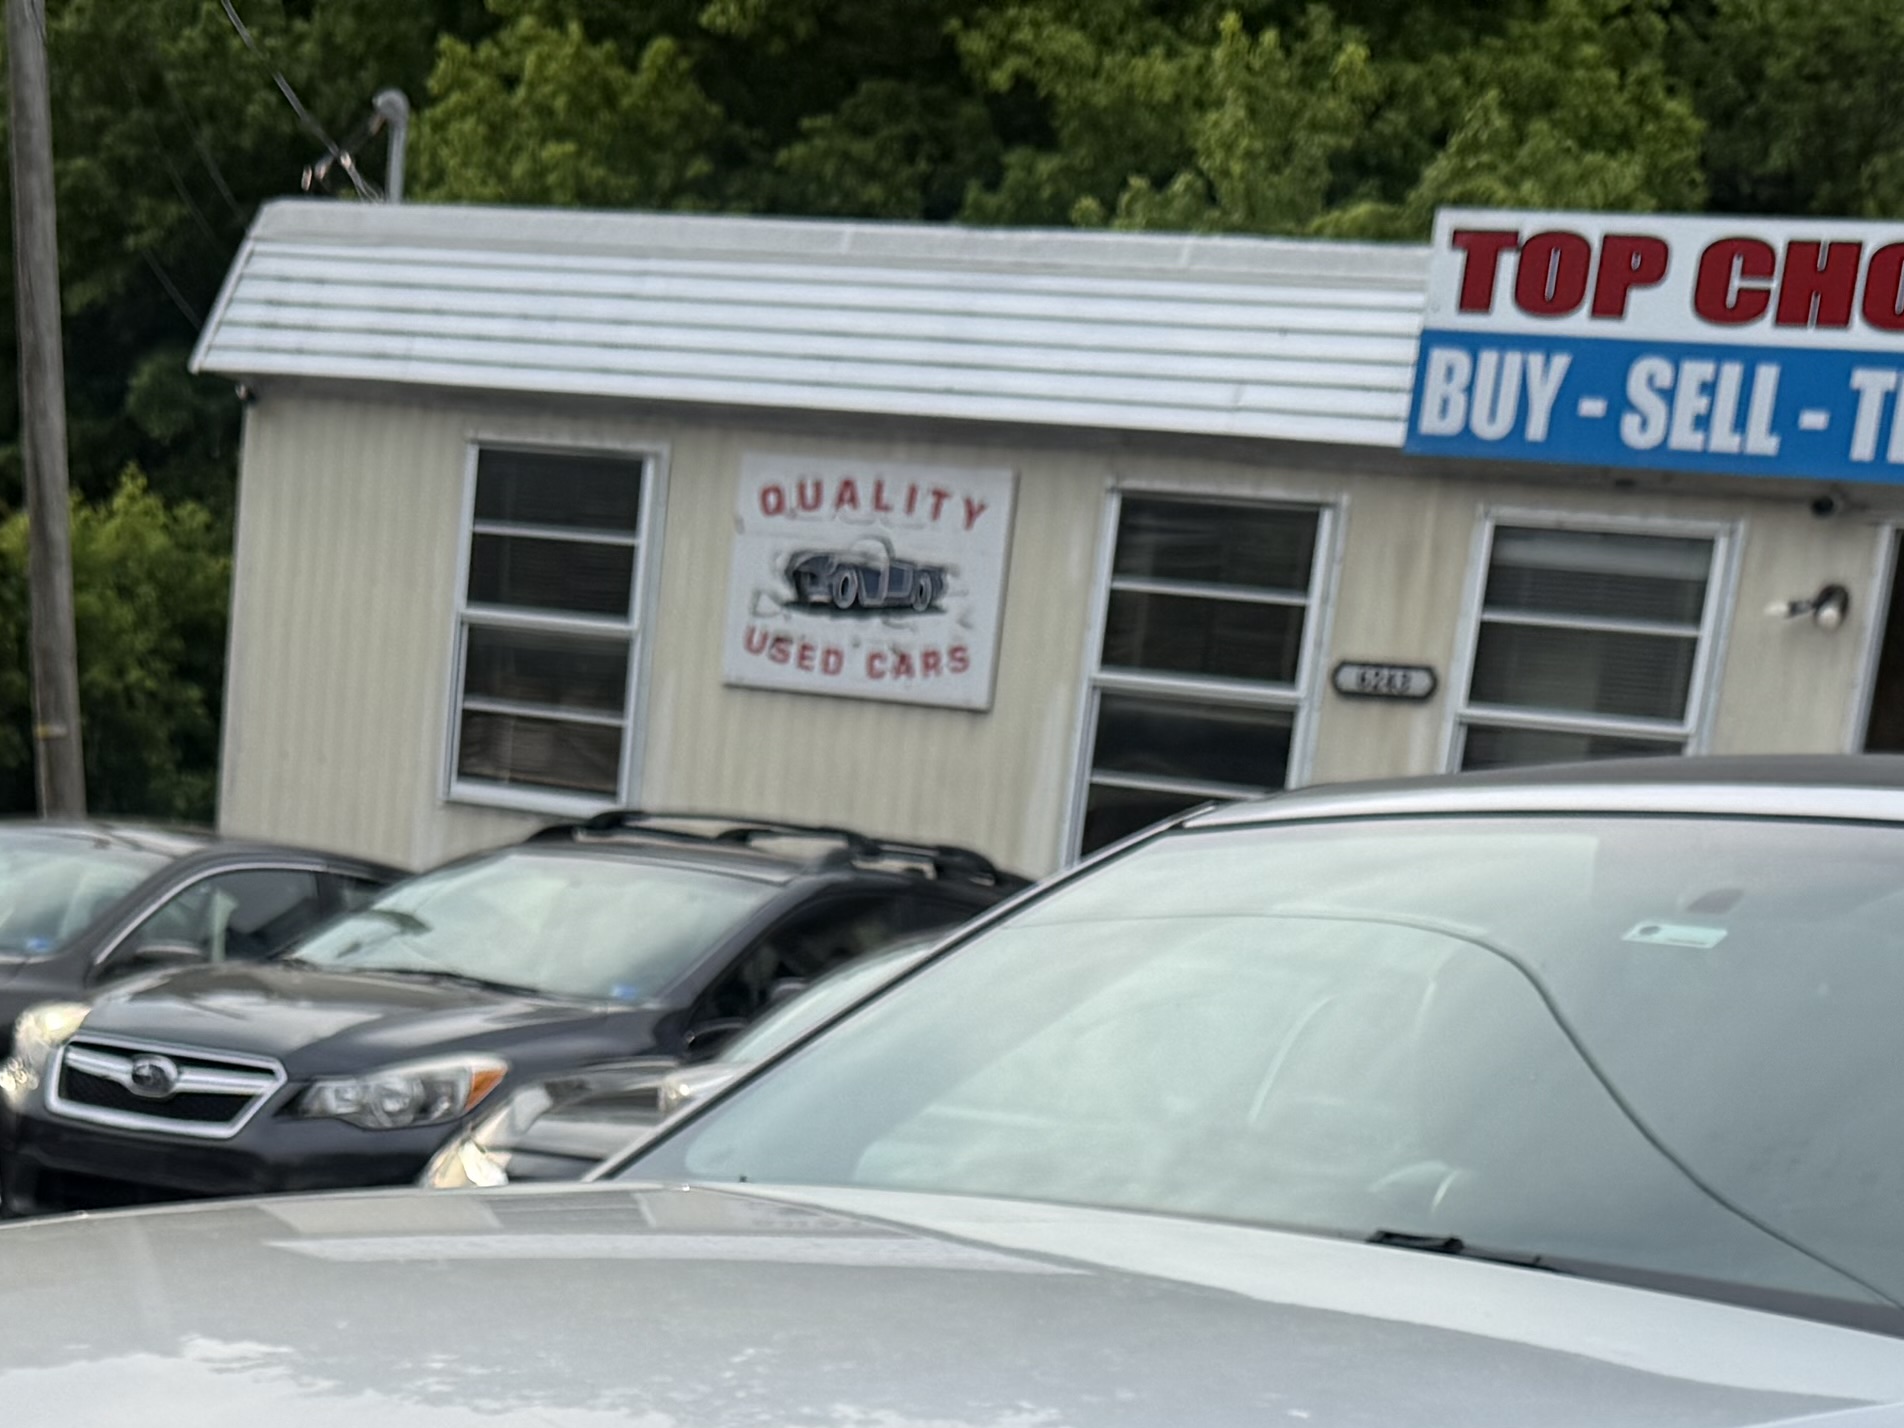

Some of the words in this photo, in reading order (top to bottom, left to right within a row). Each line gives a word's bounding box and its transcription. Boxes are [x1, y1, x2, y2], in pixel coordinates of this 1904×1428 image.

[1451, 229, 1670, 320] TOP
[1417, 343, 1573, 442] BUY
[1577, 397, 1607, 418] -
[1619, 355, 1781, 457] SELL
[1798, 410, 1831, 431] -
[759, 478, 989, 531] QUALITY
[743, 625, 844, 677] USED
[865, 645, 971, 680] CARS
